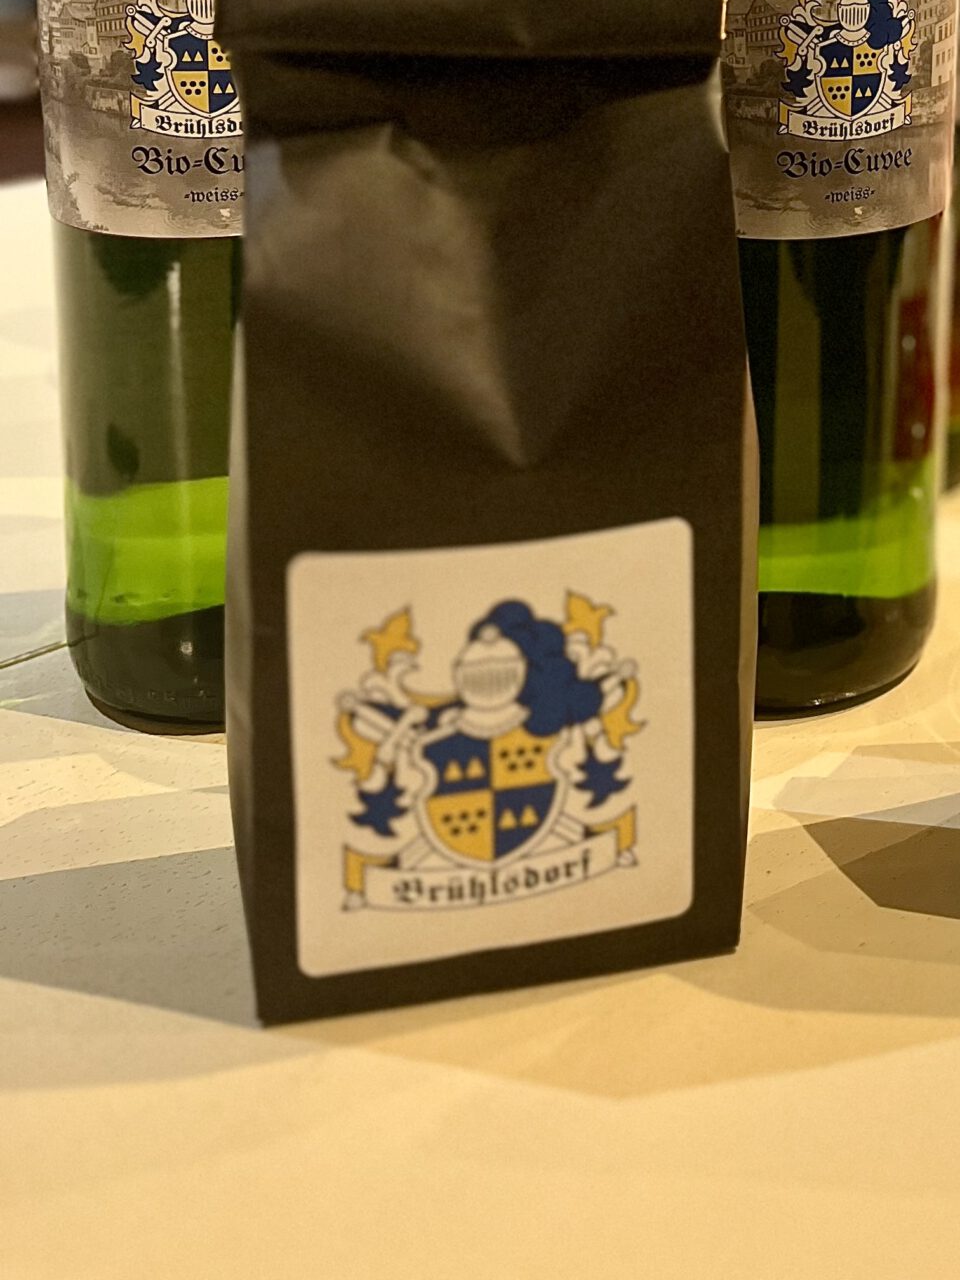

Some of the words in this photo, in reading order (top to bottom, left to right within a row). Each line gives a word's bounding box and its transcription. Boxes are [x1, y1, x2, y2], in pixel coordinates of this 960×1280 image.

[155, 115, 242, 138] Brühlsd
[802, 113, 896, 140] Brühlsdorf
[776, 148, 912, 178] Bio-Cuvee
[393, 848, 592, 906] Brühlsdorf
